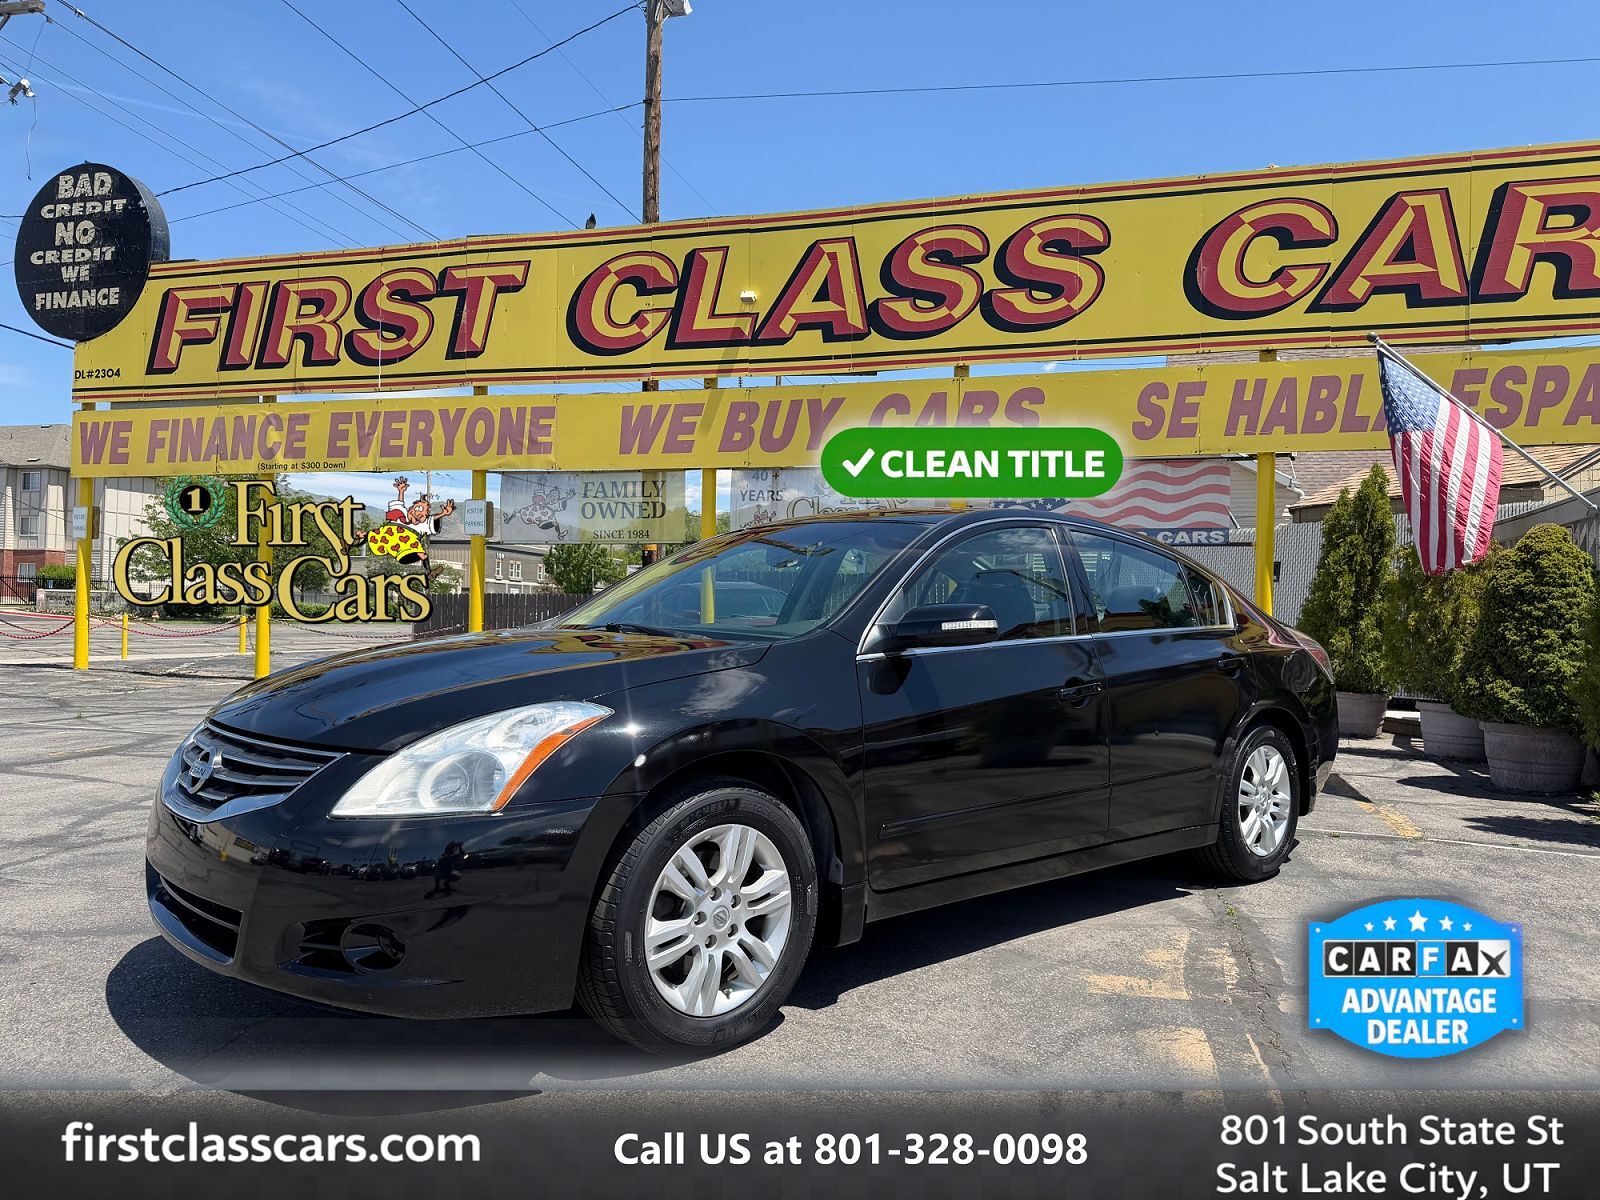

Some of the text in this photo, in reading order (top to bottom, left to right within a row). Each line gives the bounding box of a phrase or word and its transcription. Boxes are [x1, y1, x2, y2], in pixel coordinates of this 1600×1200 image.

[57, 172, 112, 199] BAD
[40, 198, 127, 219] CREDIT
[55, 219, 96, 247] NO
[30, 246, 116, 265] CREDIT
[61, 264, 91, 283] WE
[146, 176, 1600, 376] FIRST CLASS CAR
[35, 287, 120, 311] FINANCE
[74, 368, 121, 380] DL#2304
[1131, 381, 1208, 442] SE
[79, 405, 557, 466] WE FINANCE EVERYONE
[618, 402, 705, 455] WE
[717, 397, 846, 453] BUY
[301, 462, 320, 470] $300
[323, 461, 346, 470] Down)
[752, 471, 767, 481] 40
[582, 480, 667, 498] FAMILY
[739, 489, 784, 502] YEARS
[186, 488, 203, 512] 1
[581, 501, 667, 520] OWNED
[228, 479, 366, 579] First
[593, 530, 650, 539] SINCE 1984
[1156, 532, 1226, 545] CARS
[113, 536, 434, 624] Class Cars
